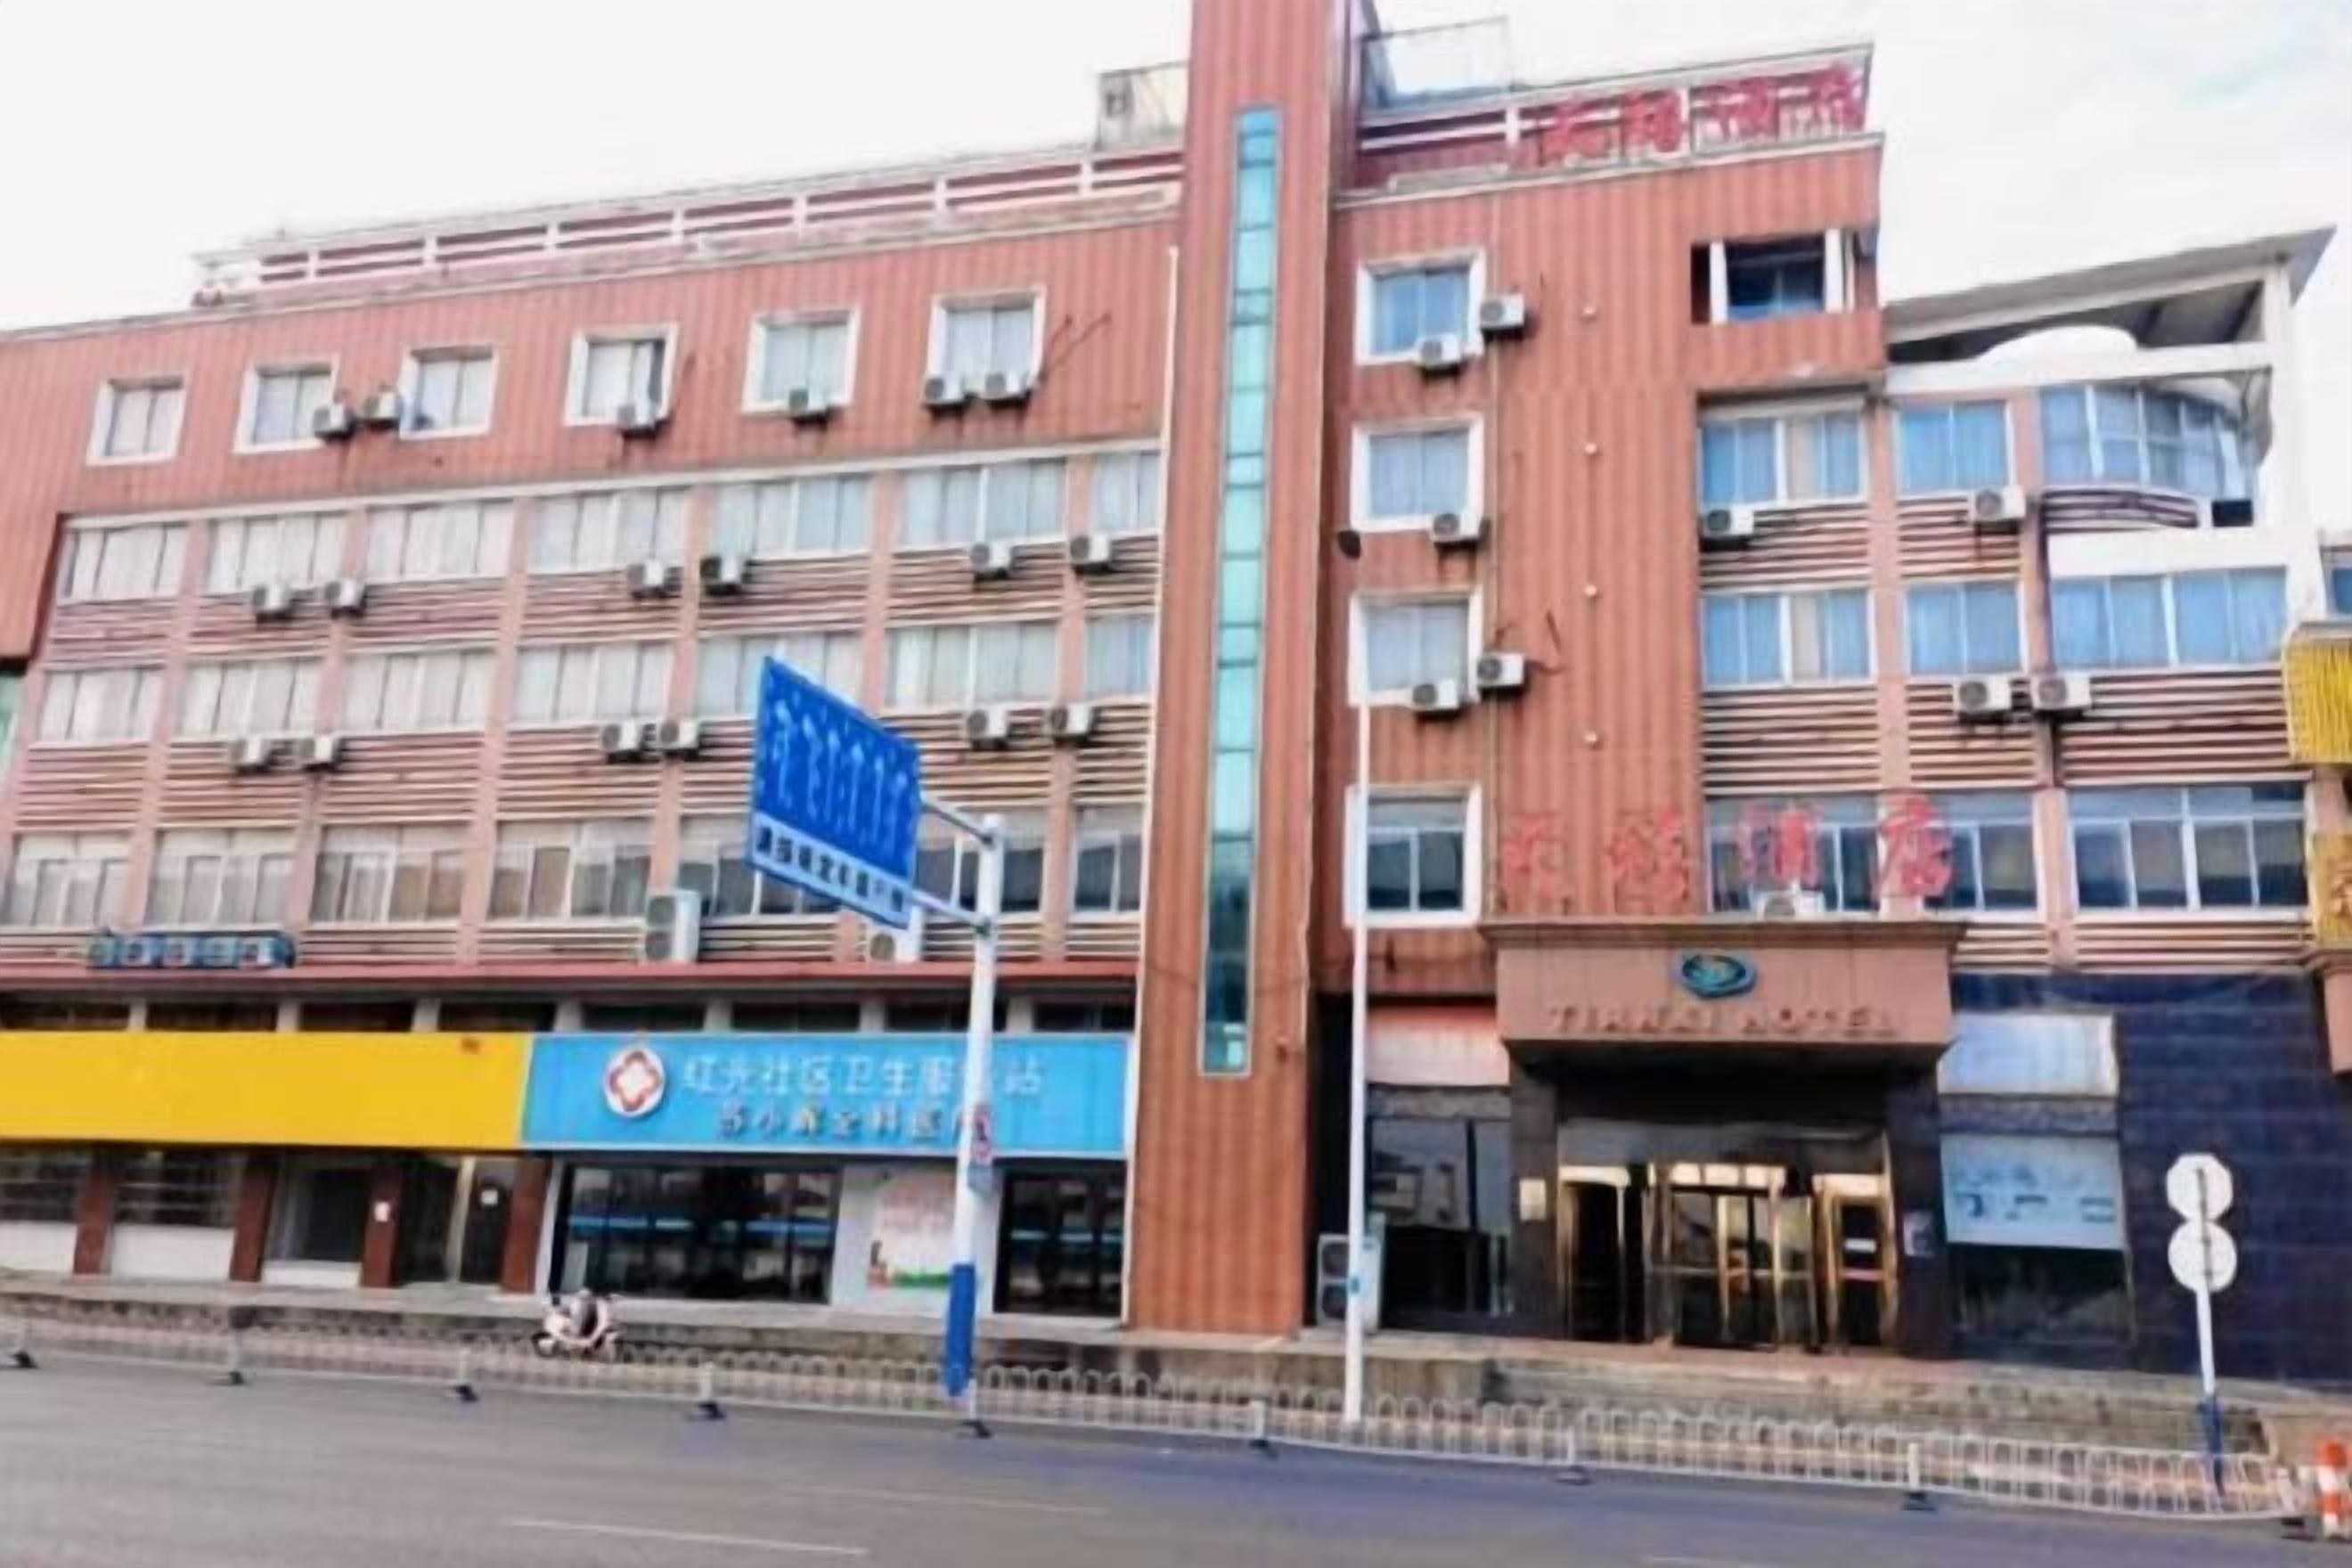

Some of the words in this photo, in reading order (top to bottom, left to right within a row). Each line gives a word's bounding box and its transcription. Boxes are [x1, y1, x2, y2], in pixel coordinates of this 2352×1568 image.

[683, 1053, 1042, 1097] 红光社区卫生服站
